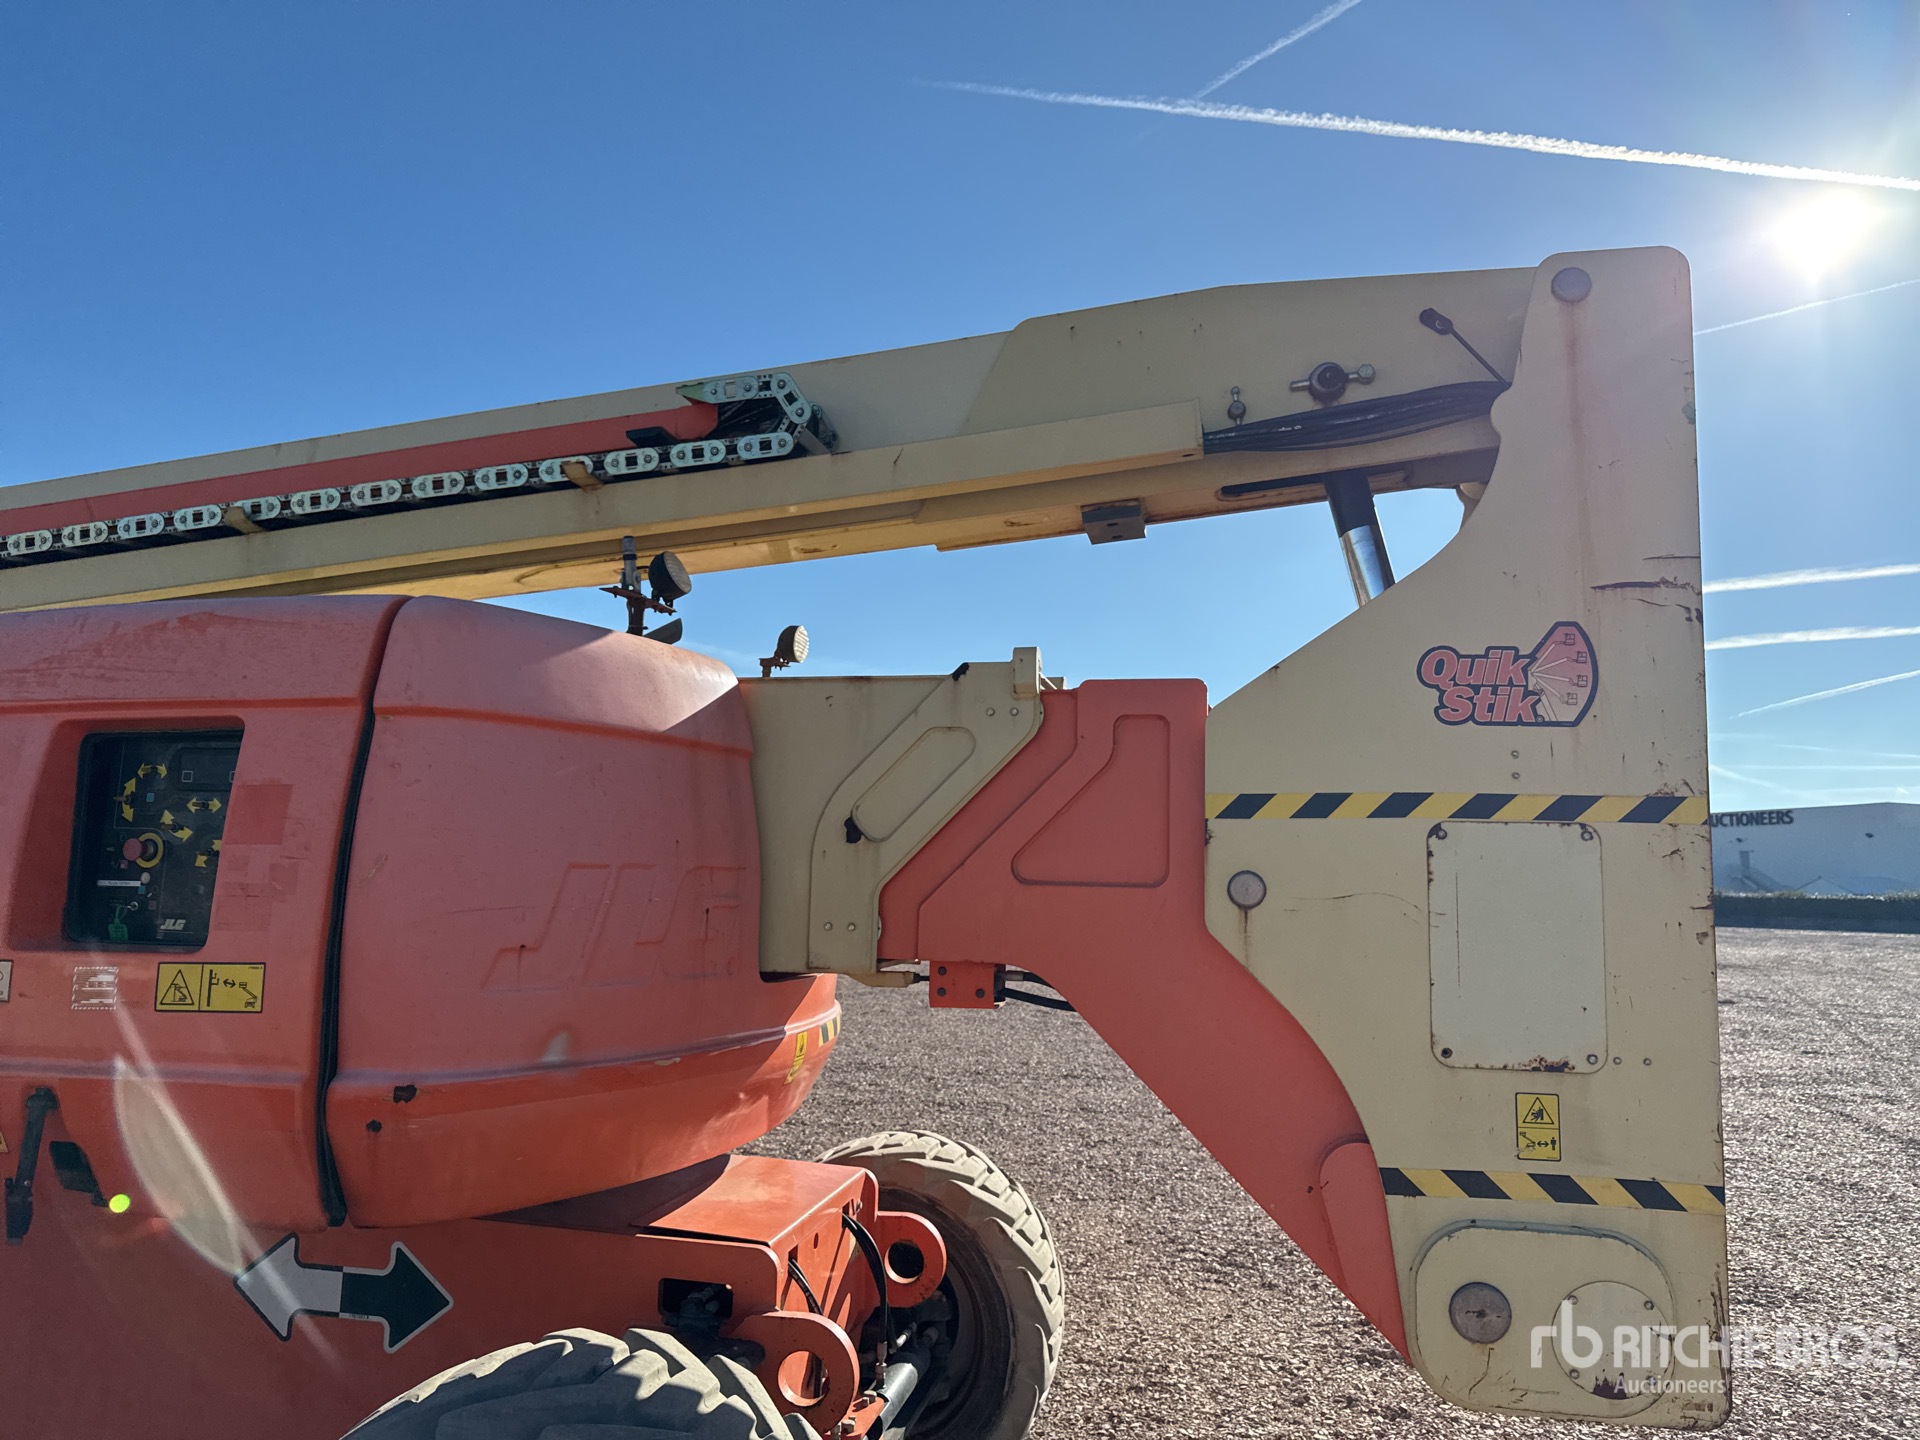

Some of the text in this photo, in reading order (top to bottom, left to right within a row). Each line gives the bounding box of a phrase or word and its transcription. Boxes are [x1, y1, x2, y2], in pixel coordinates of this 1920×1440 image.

[1420, 649, 1530, 690] Quik
[1438, 686, 1540, 722] Stik
[1711, 810, 1794, 827] UCTIONEERS
[160, 918, 187, 931] JLG
